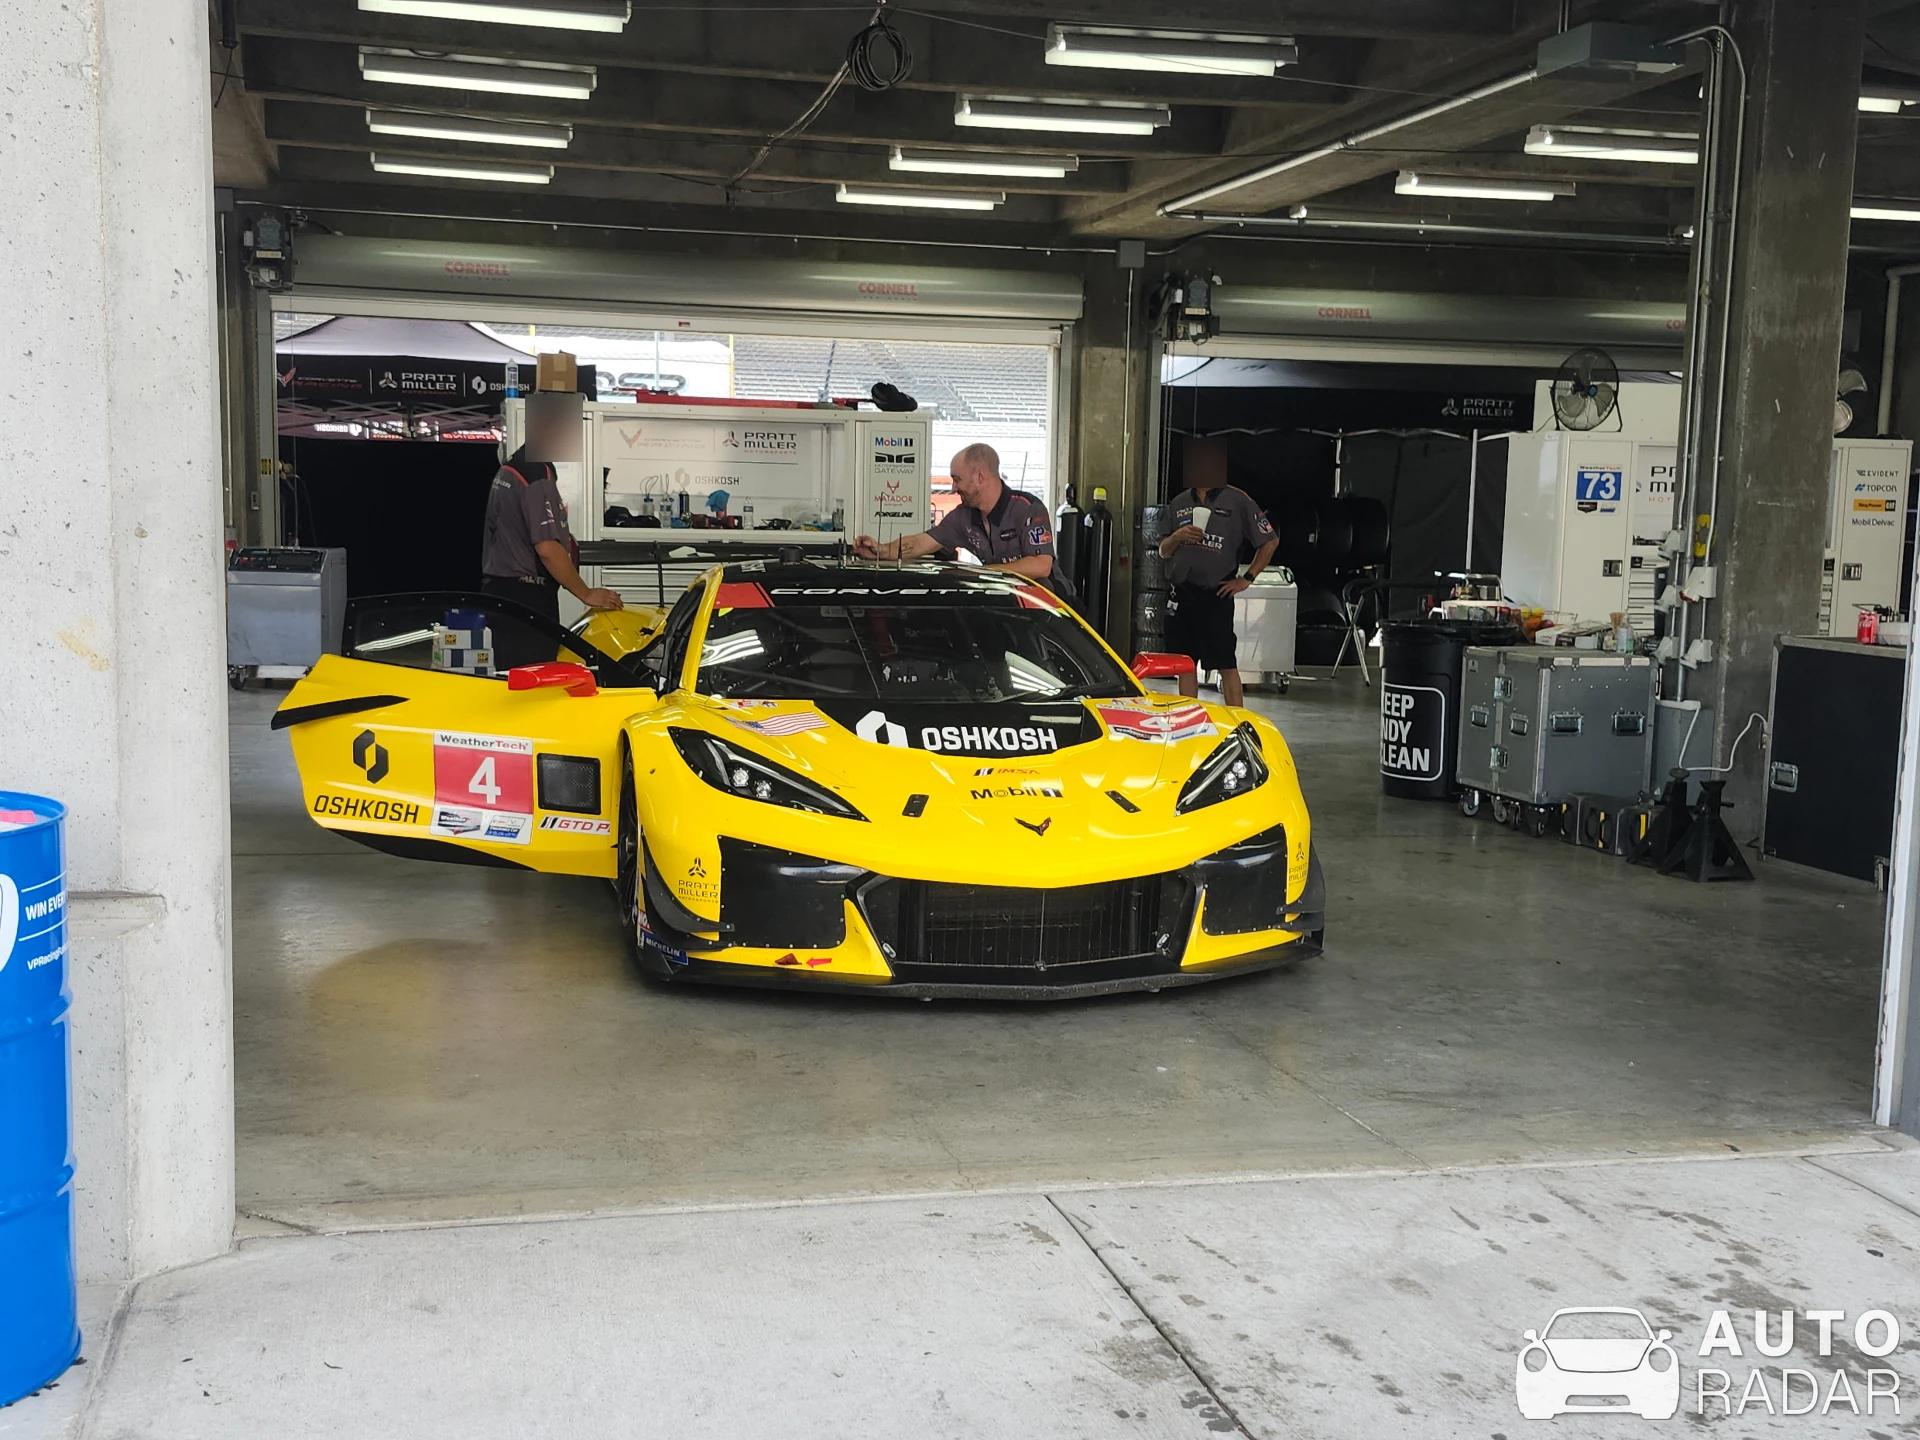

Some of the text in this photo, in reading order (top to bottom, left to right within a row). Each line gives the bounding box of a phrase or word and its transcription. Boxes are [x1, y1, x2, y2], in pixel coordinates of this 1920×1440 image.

[444, 262, 509, 276] CORNELL
[858, 282, 918, 296] CORNELL
[1318, 307, 1372, 320] CORNELL
[402, 373, 456, 382] PRATT
[402, 381, 457, 391] MILLER
[490, 382, 530, 391] OSHSH
[1463, 398, 1515, 408] PRATT
[1463, 407, 1514, 417] MILLER
[744, 432, 797, 441] PRATT
[875, 437, 902, 447] Mobil
[744, 440, 797, 450] MILLER
[695, 476, 740, 485] OSHKOSH
[1583, 472, 1616, 500] 73
[874, 495, 913, 503] MATADOR
[1852, 518, 1895, 527] Mobil Delvac
[1203, 532, 1224, 543] ATT
[770, 588, 1014, 596] CORVETTE
[1382, 692, 1415, 718] EEP
[1139, 716, 1176, 732] 4
[1382, 717, 1412, 744] NDY
[440, 734, 528, 751] WeatherTech
[921, 726, 1058, 750] OSHKOSH
[1381, 743, 1430, 772] LEAN
[468, 756, 502, 805] 4
[970, 786, 1037, 800] Mobil
[313, 795, 419, 824] OSHKOSH
[558, 819, 594, 831] GTD
[678, 880, 719, 890] PRATT
[678, 888, 719, 899] MILLER
[25, 900, 47, 921] WIN
[645, 938, 681, 957] MICHELIN
